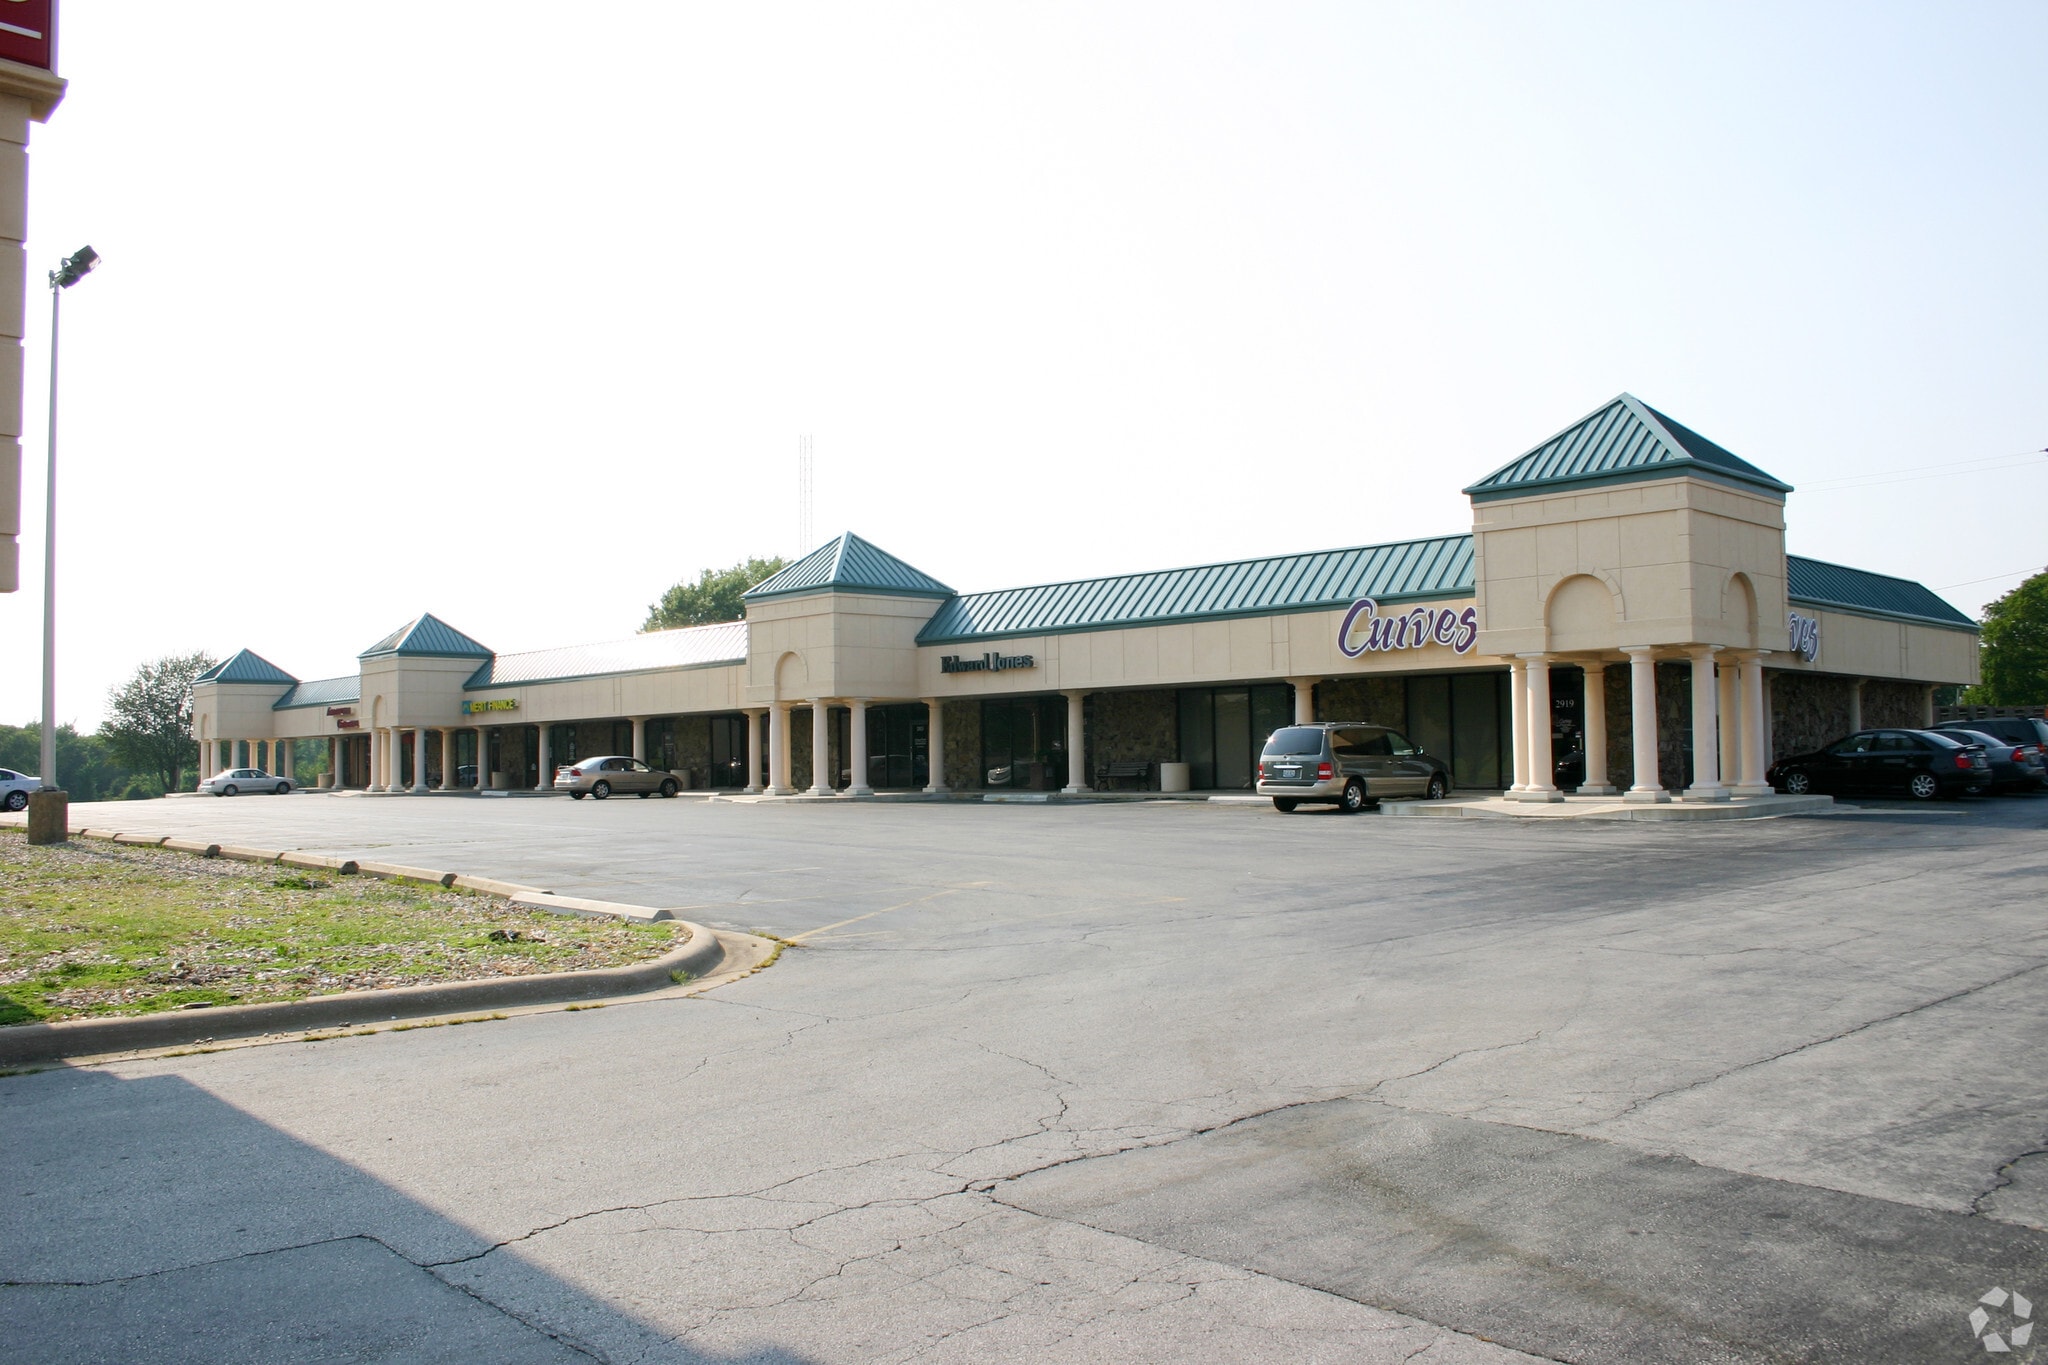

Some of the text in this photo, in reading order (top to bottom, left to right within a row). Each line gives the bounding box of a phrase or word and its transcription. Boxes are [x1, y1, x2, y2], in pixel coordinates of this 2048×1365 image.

[1338, 598, 1477, 658] Curves
[940, 652, 1034, 673] Edward Jones
[470, 699, 516, 712] MERIT FINANCE
[1555, 699, 1575, 708] 2919
